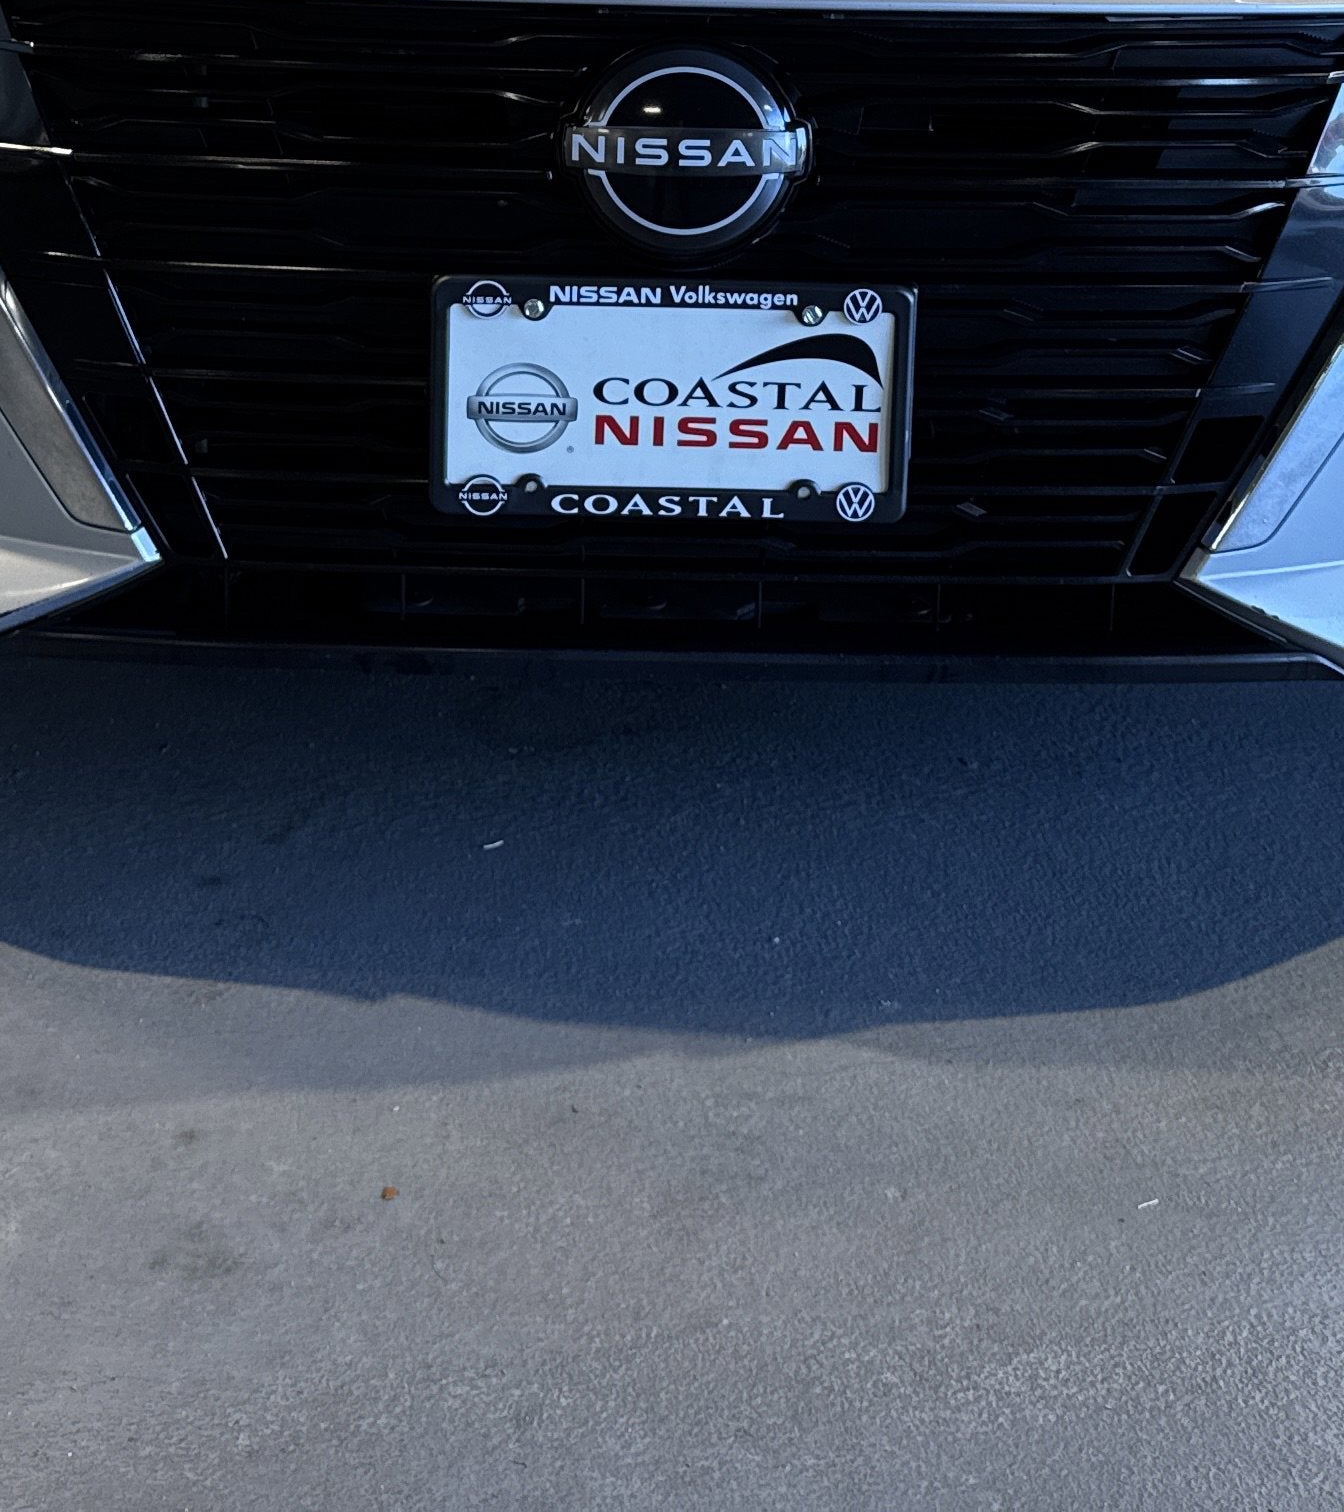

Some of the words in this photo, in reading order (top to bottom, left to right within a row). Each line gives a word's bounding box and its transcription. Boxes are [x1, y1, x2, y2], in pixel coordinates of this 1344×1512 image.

[570, 133, 798, 168] NISSAN
[462, 294, 513, 307] NISSAN
[549, 285, 662, 305] NISSAN
[669, 285, 799, 310] Volkswagen
[593, 376, 882, 414] COASTAL
[476, 400, 568, 417] NISSAN
[594, 414, 879, 454] NISSAN
[458, 490, 508, 503] NISSAN
[550, 494, 785, 519] COASTAL
